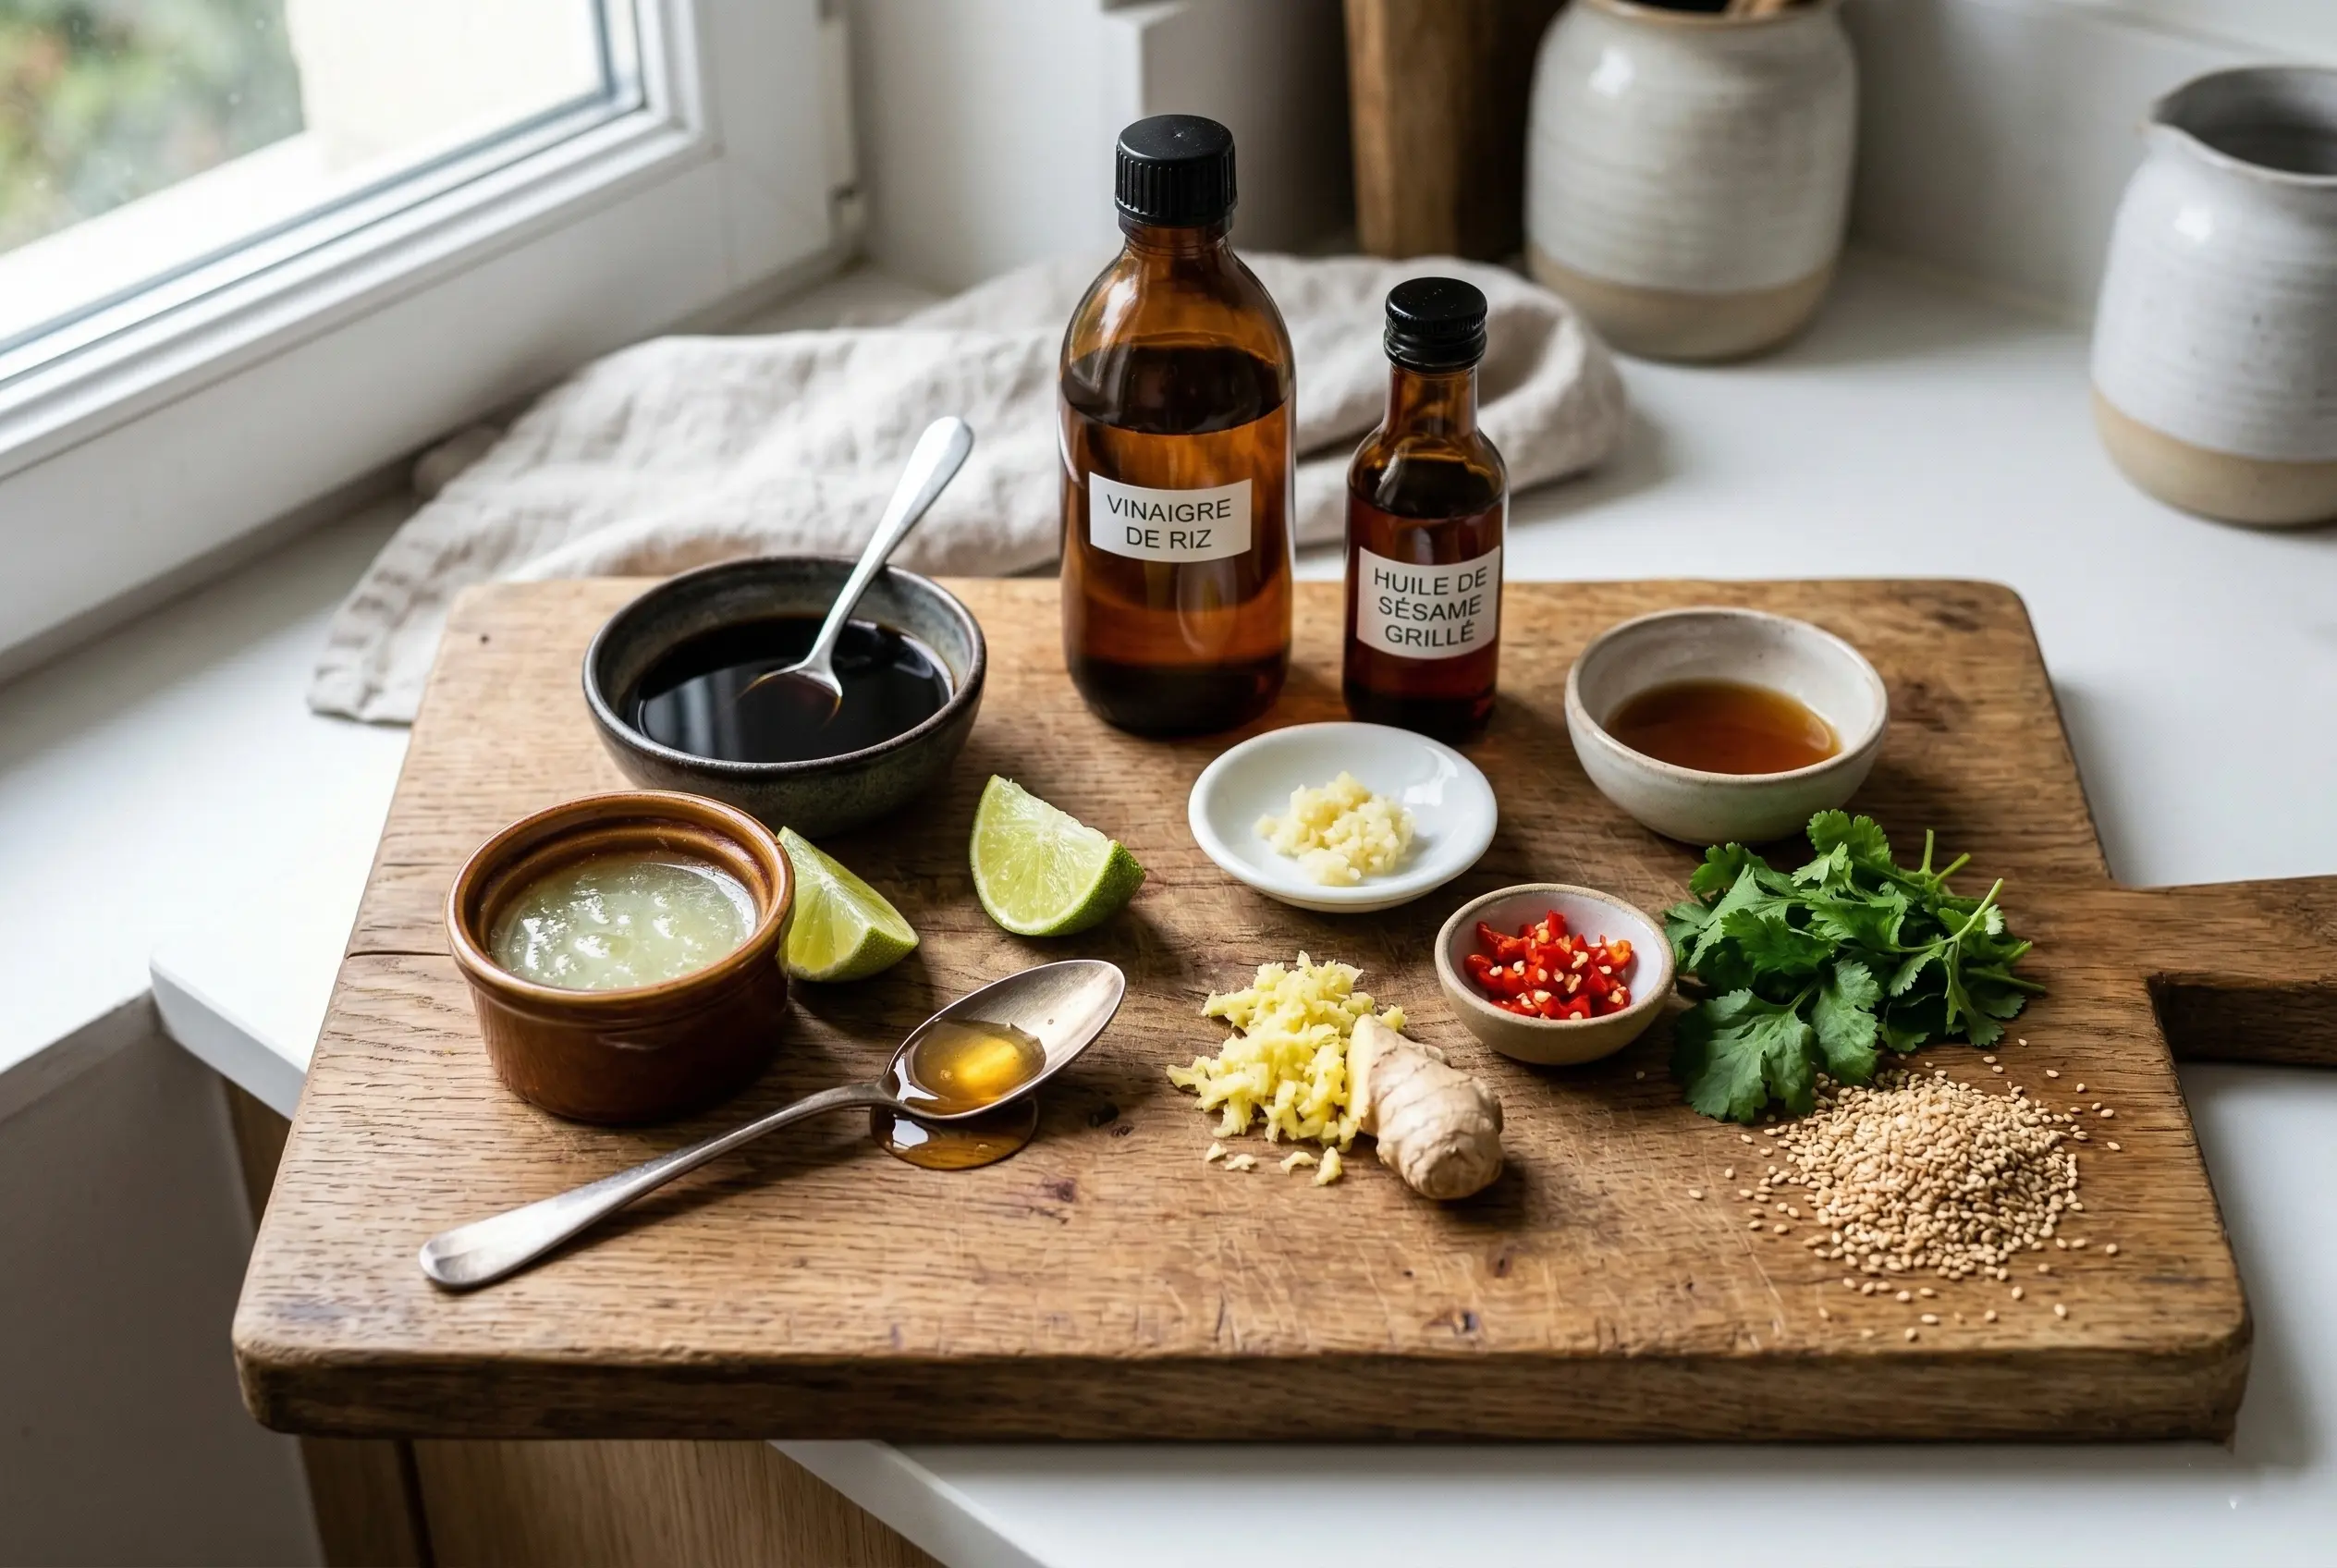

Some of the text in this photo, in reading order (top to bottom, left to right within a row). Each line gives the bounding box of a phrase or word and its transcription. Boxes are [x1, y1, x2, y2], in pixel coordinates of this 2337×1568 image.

[1107, 493, 1231, 522] VINAIGRE
[1126, 525, 1212, 549] DE RIZ
[1374, 566, 1487, 596] HUILE DE
[1377, 594, 1482, 621] SÉSAME
[1384, 619, 1475, 648] GRILLÉ
